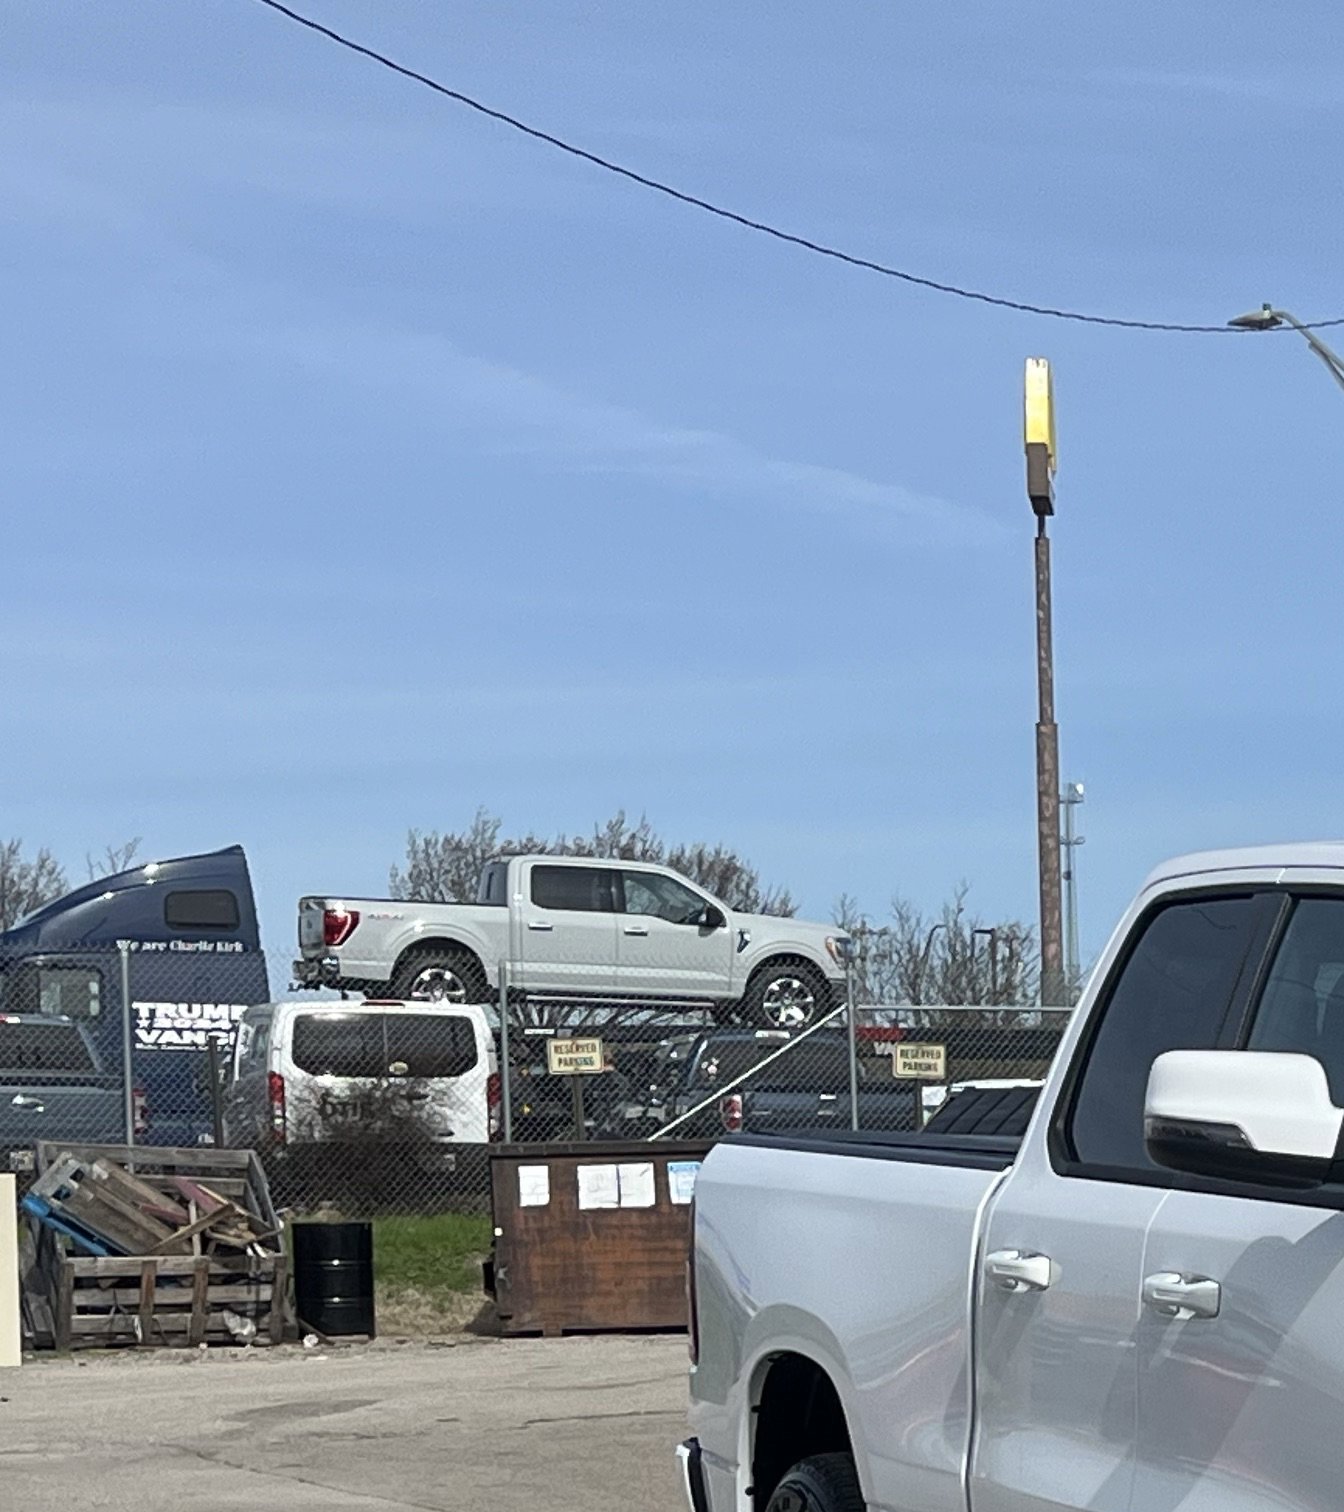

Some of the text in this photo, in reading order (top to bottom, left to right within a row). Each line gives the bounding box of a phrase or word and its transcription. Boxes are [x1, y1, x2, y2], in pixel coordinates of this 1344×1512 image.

[115, 939, 243, 952] We are Charlie Kirk
[554, 1042, 597, 1054] RESERVED
[900, 1048, 941, 1059] RESERVED
[558, 1056, 594, 1067] PARKING
[903, 1061, 938, 1072] PARKING
